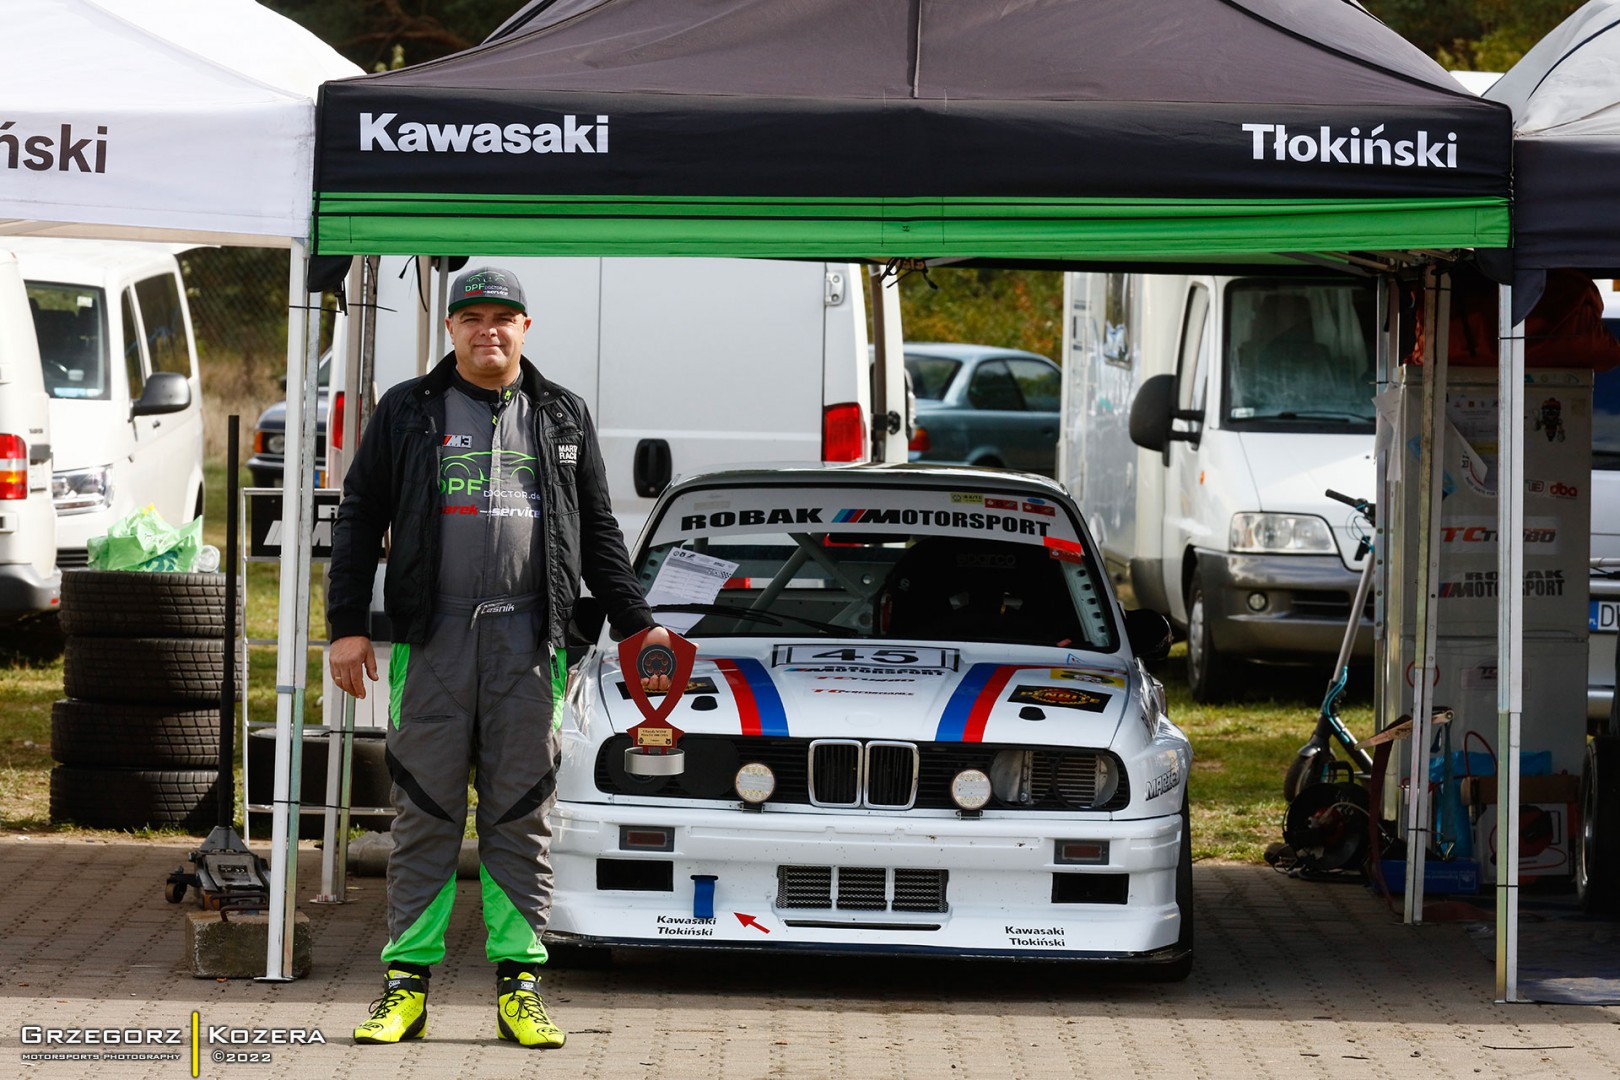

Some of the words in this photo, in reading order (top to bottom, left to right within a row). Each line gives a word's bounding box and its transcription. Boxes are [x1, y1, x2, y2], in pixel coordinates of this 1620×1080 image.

[360, 112, 609, 154] Kawasaki
[1242, 123, 1457, 168] Tłokiński
[1549, 483, 1578, 497] dba
[680, 508, 824, 532] ROBAK
[857, 508, 1051, 537] MOTORSPORT
[1465, 570, 1563, 581] ROAK
[812, 649, 919, 664] 45
[657, 915, 717, 925] Kawasaki
[657, 926, 714, 936] Tłokiński
[1004, 926, 1065, 936] Kawasaki
[1009, 937, 1066, 946] Tłokiński
